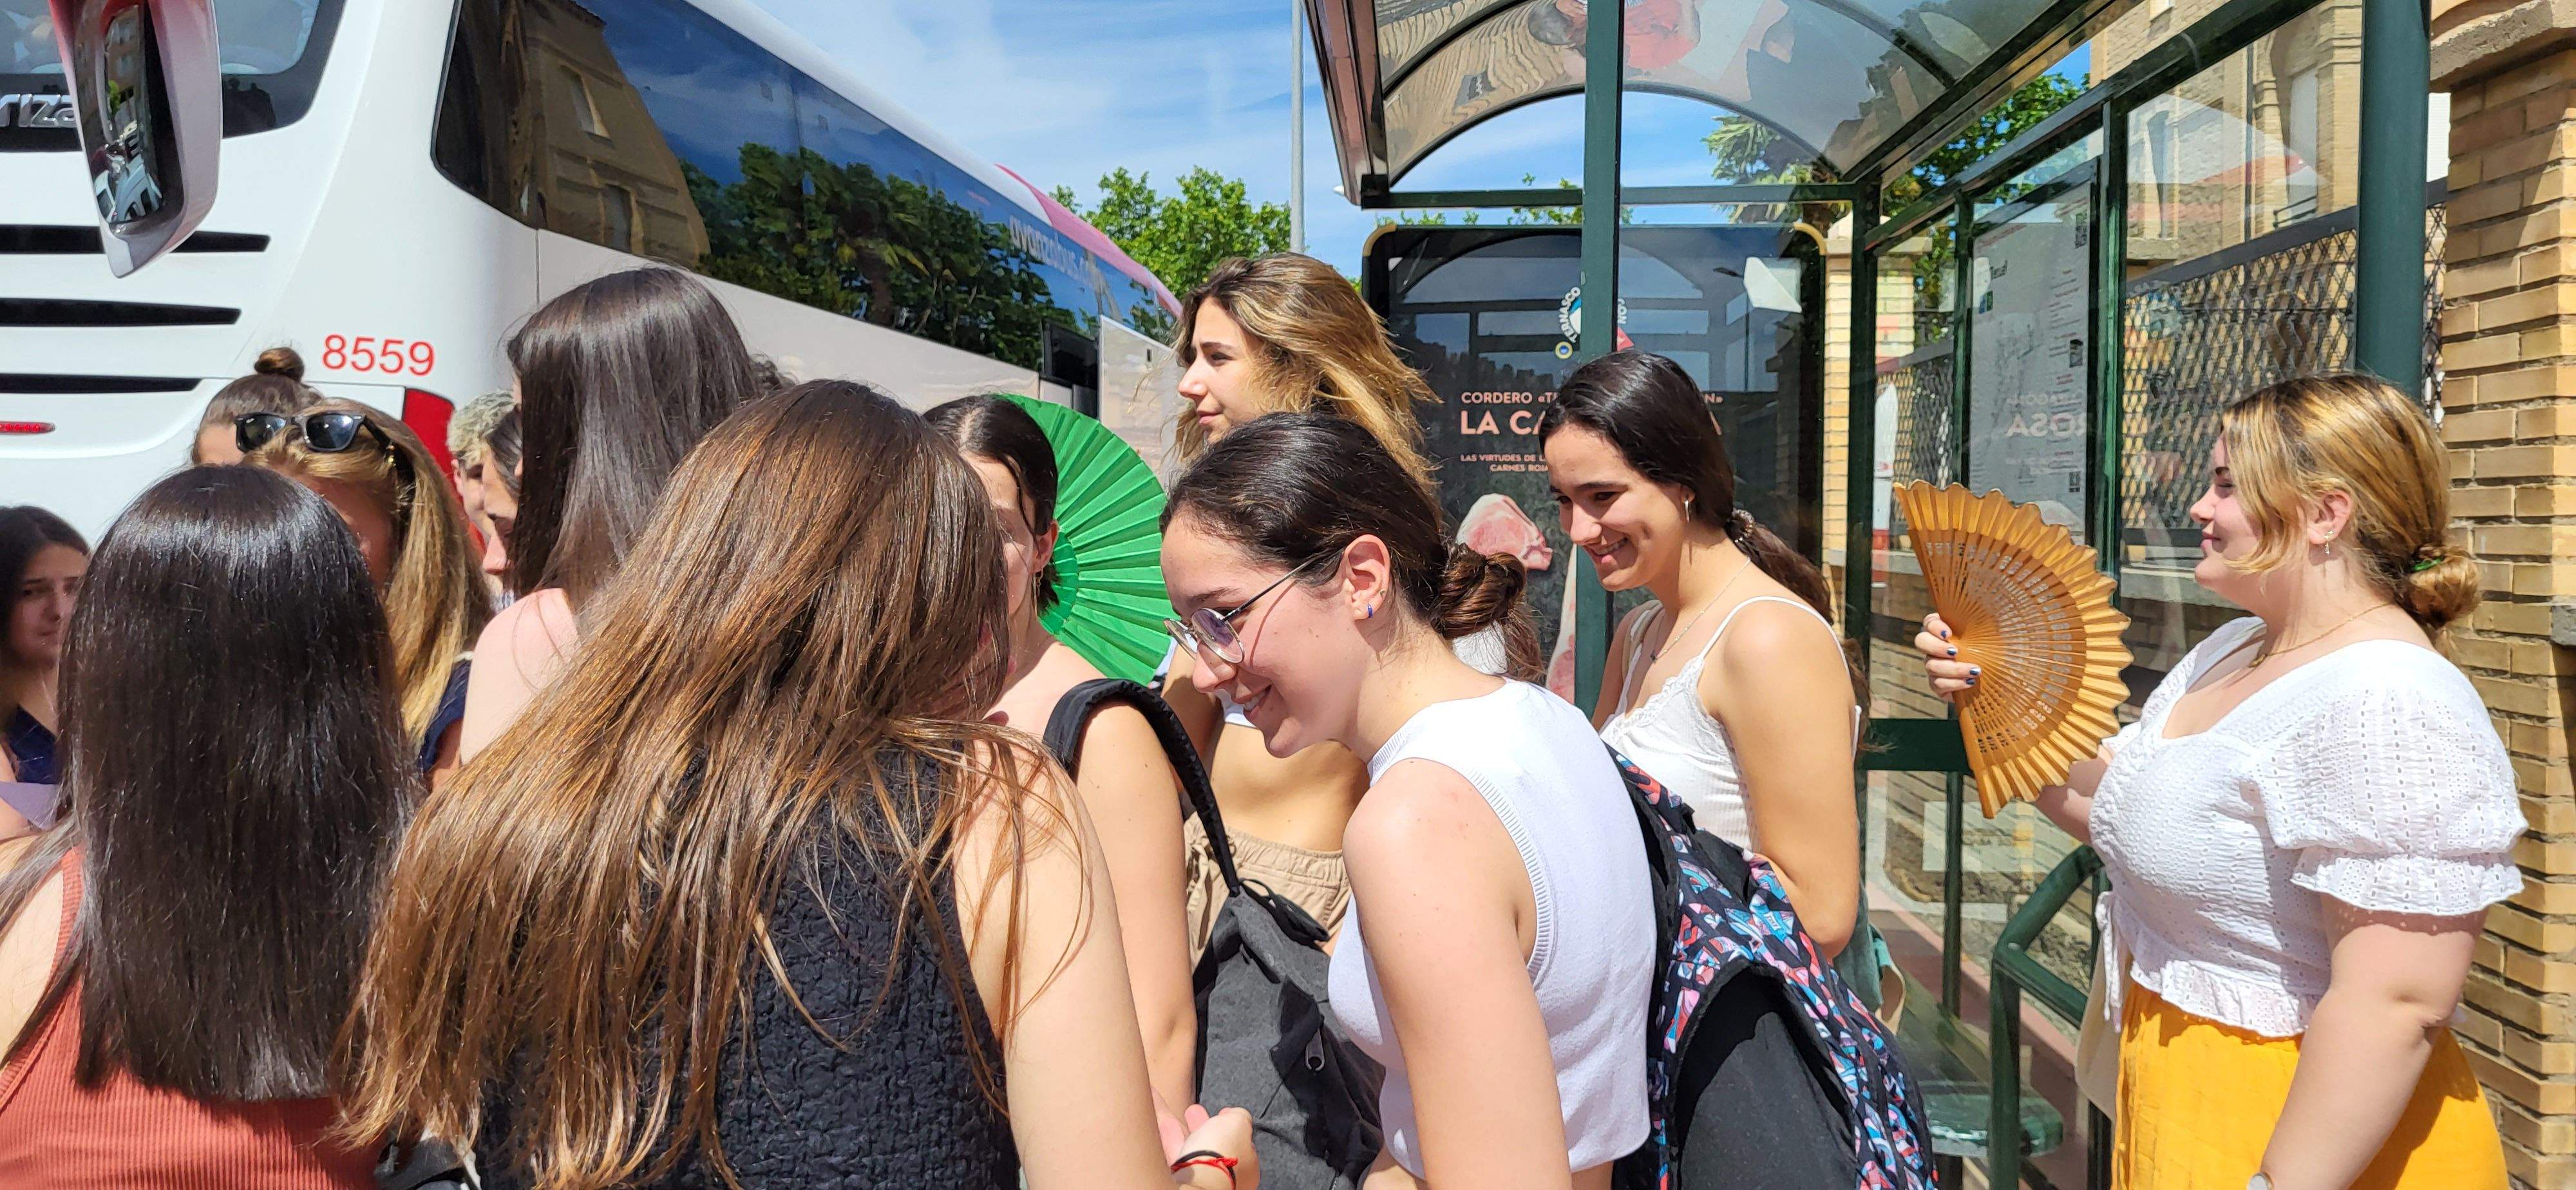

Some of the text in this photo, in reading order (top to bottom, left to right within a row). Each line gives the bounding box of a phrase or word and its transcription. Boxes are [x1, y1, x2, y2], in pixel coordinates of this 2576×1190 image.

[1558, 287, 1581, 343] TERNASCO
[323, 334, 434, 376] 8559
[1461, 392, 1533, 404] CORDERO
[1461, 410, 1500, 435] LA
